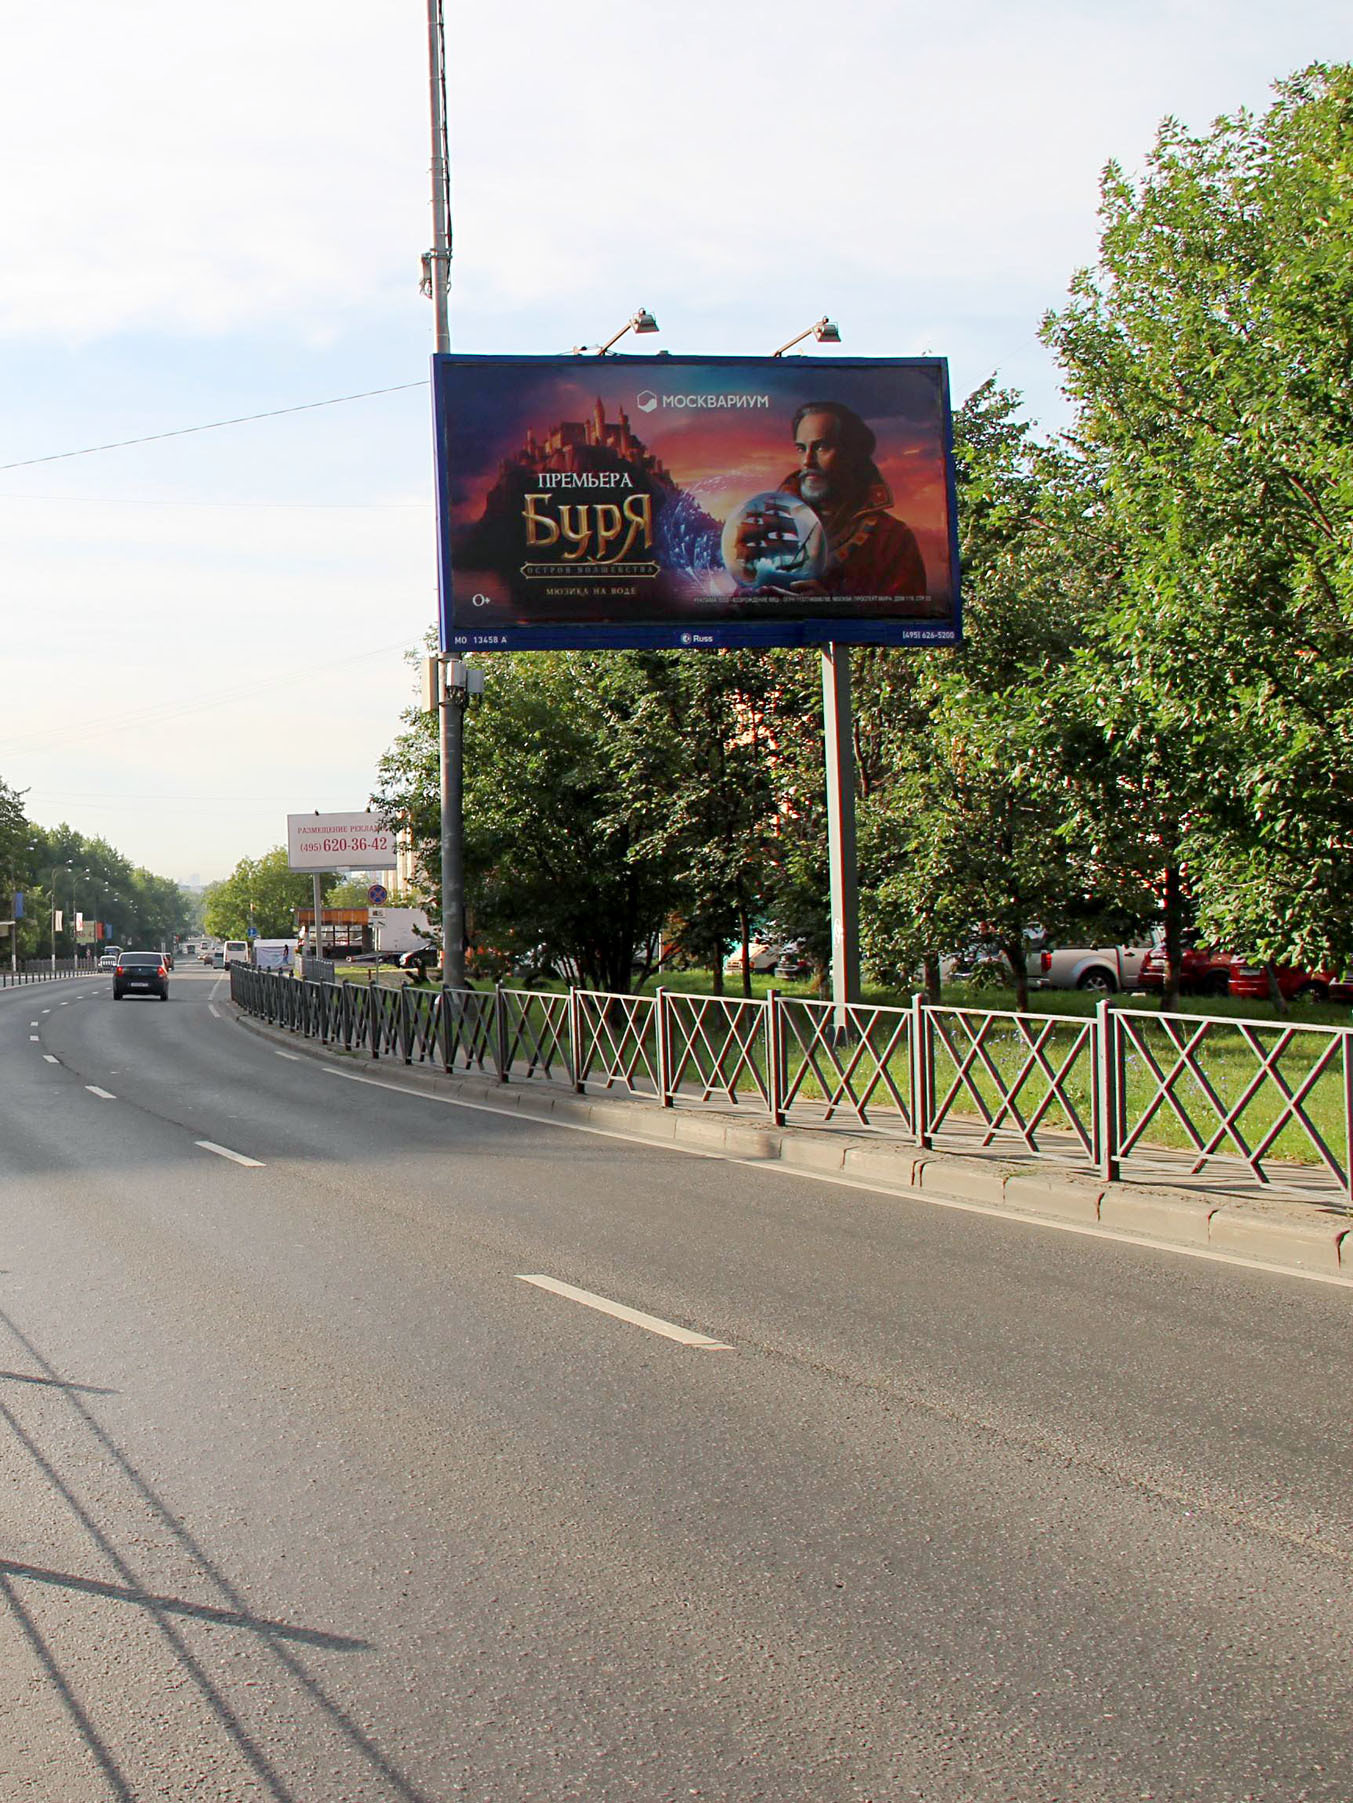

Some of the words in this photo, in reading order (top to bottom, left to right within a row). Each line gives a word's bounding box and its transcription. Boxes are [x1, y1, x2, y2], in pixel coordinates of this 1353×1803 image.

[662, 395, 769, 408] МОСКВАРИУМ
[537, 472, 634, 489] ПРЕМЬЕРА
[526, 566, 573, 575] ОСТРОВ
[593, 586, 607, 595] НА
[611, 586, 637, 595] ВОДЕ
[473, 636, 499, 644] 13458
[693, 634, 713, 643] Russ
[297, 826, 348, 834] РАЗМЕЩЕНИЕ
[350, 824, 389, 833] РЕКЛАМ
[300, 842, 322, 853] (495)
[323, 836, 388, 852] 620-36-42
